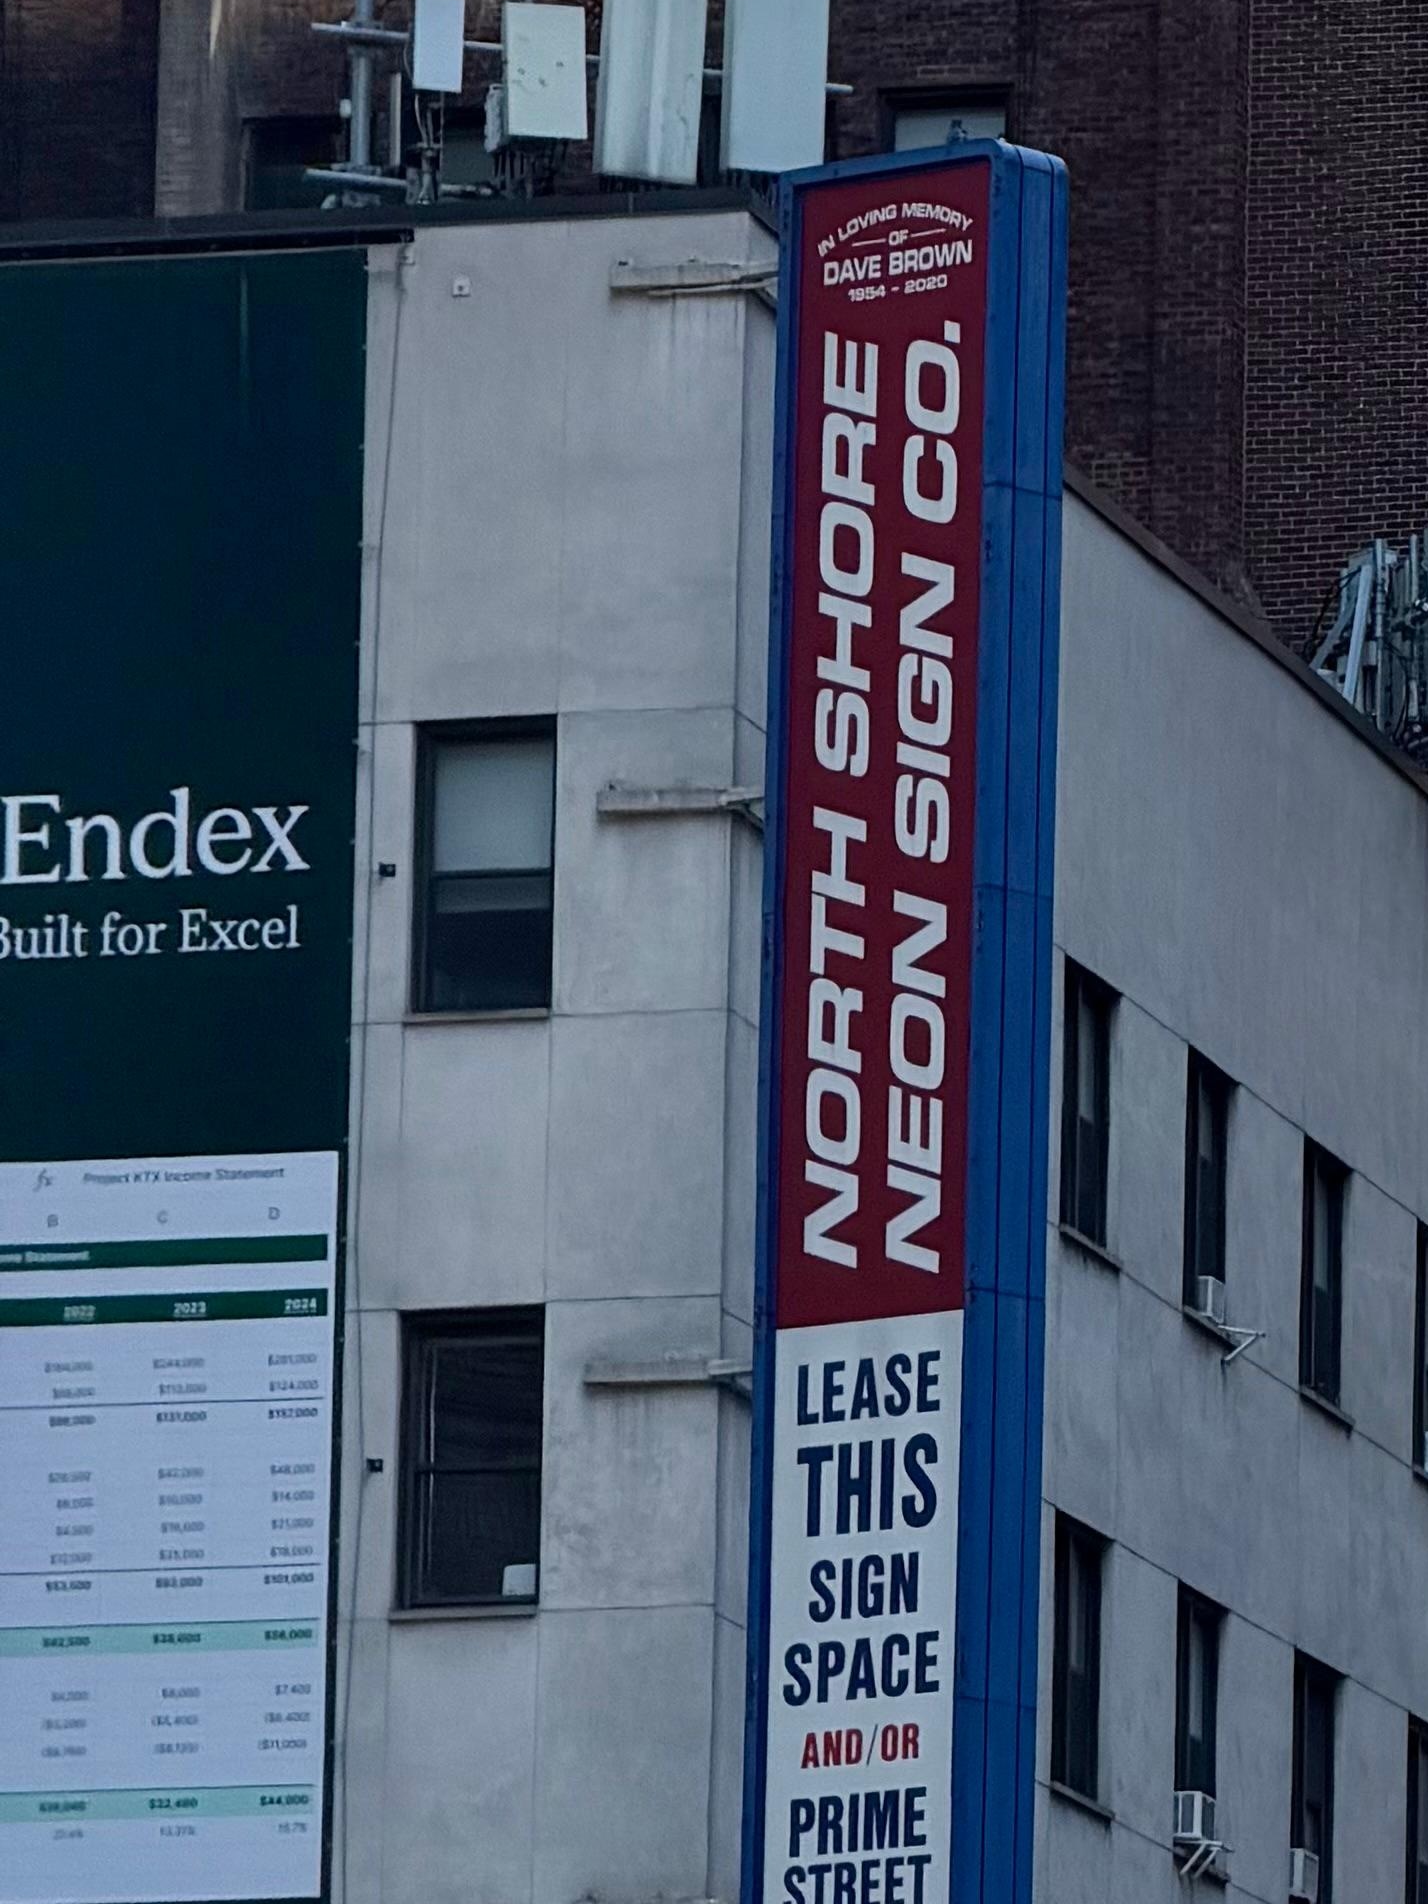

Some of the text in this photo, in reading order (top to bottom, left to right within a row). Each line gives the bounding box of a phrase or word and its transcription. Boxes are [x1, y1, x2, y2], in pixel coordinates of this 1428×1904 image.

[817, 202, 974, 257] IN LOVING MEMORY
[823, 239, 972, 286] DAVE BROWN
[888, 229, 909, 246] OF
[848, 284, 886, 302] 1954
[904, 274, 947, 294] 2020
[803, 330, 880, 1268] NORTH SHORE
[885, 320, 962, 1274] NEON SIGN CO.
[2, 786, 310, 885] Endex
[101, 910, 166, 956] for
[178, 904, 301, 953] Excel
[797, 1349, 941, 1429] LEASE
[796, 1432, 939, 1539] THIS
[808, 1551, 920, 1624] SIGN
[783, 1629, 940, 1708] SPACE
[800, 1723, 921, 1772] AND/OR
[789, 1784, 927, 1859] PRIME
